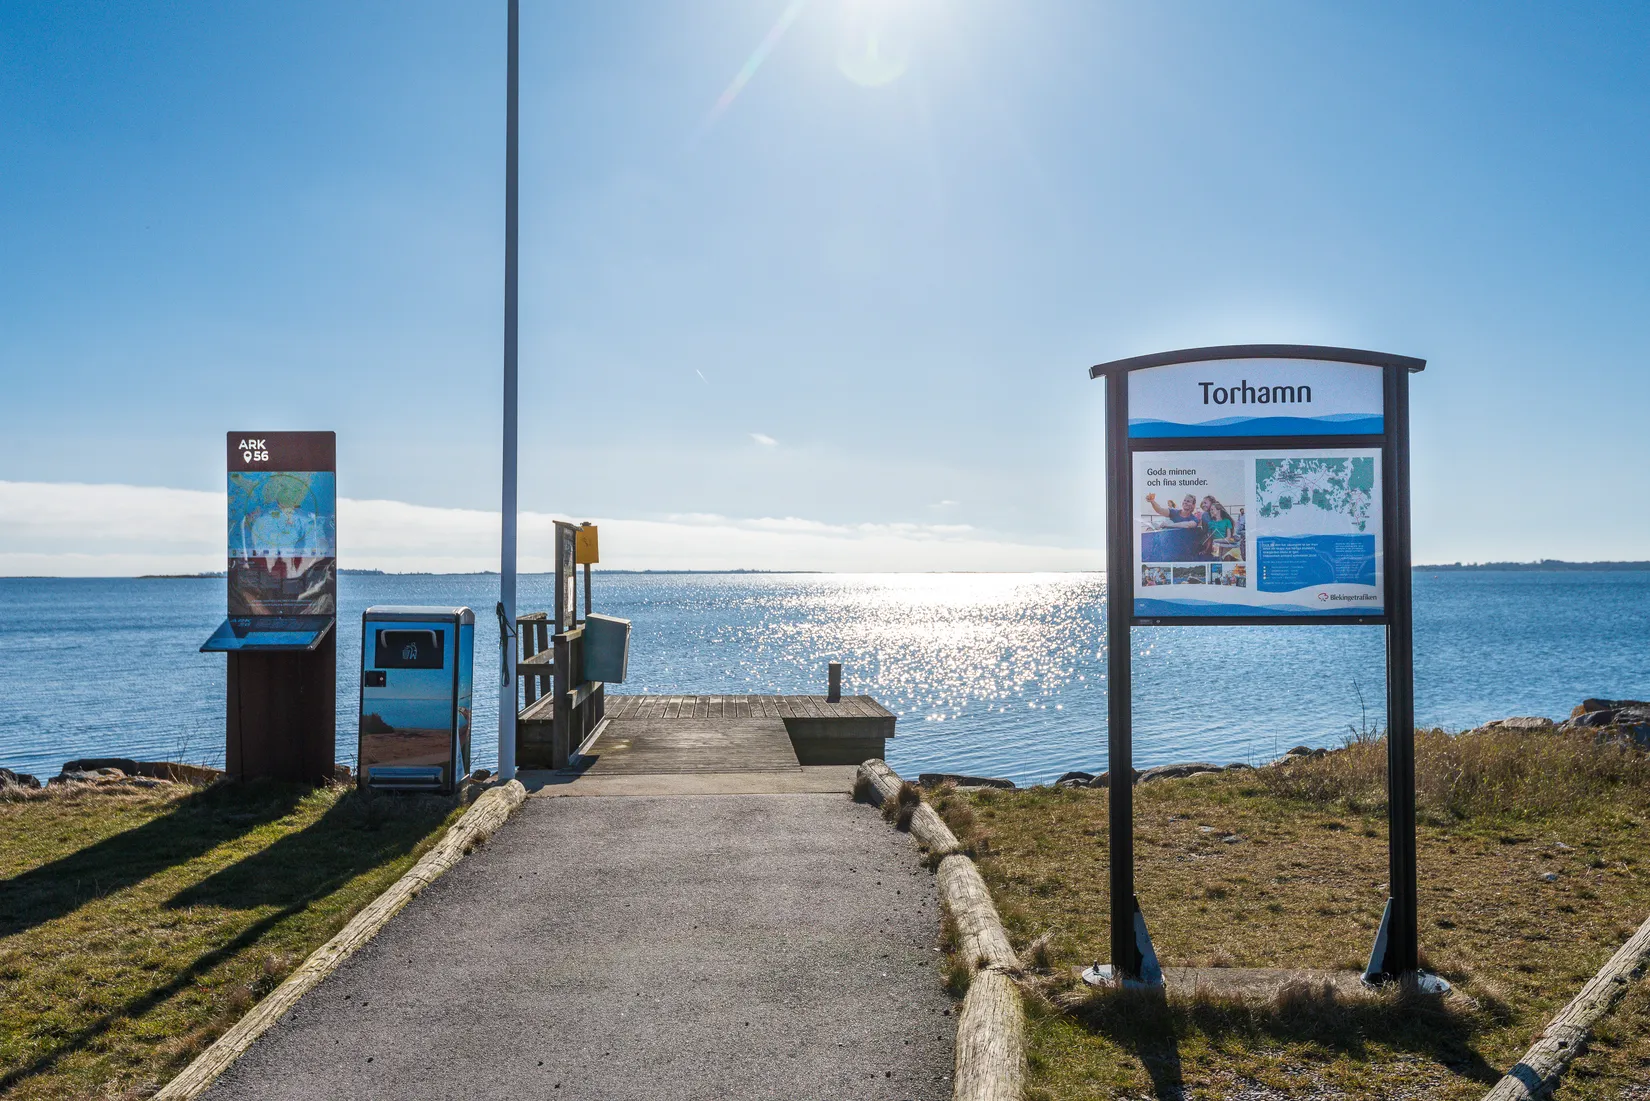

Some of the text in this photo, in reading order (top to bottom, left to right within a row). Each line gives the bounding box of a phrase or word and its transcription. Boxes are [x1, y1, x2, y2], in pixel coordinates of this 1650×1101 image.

[1198, 379, 1312, 405] Torhamn
[238, 439, 267, 450] ARK
[253, 450, 269, 462] 56
[1146, 467, 1196, 476] Goda minnen
[1146, 477, 1208, 487] och fina stunder.
[1330, 593, 1378, 602] Blekingetrafiken
